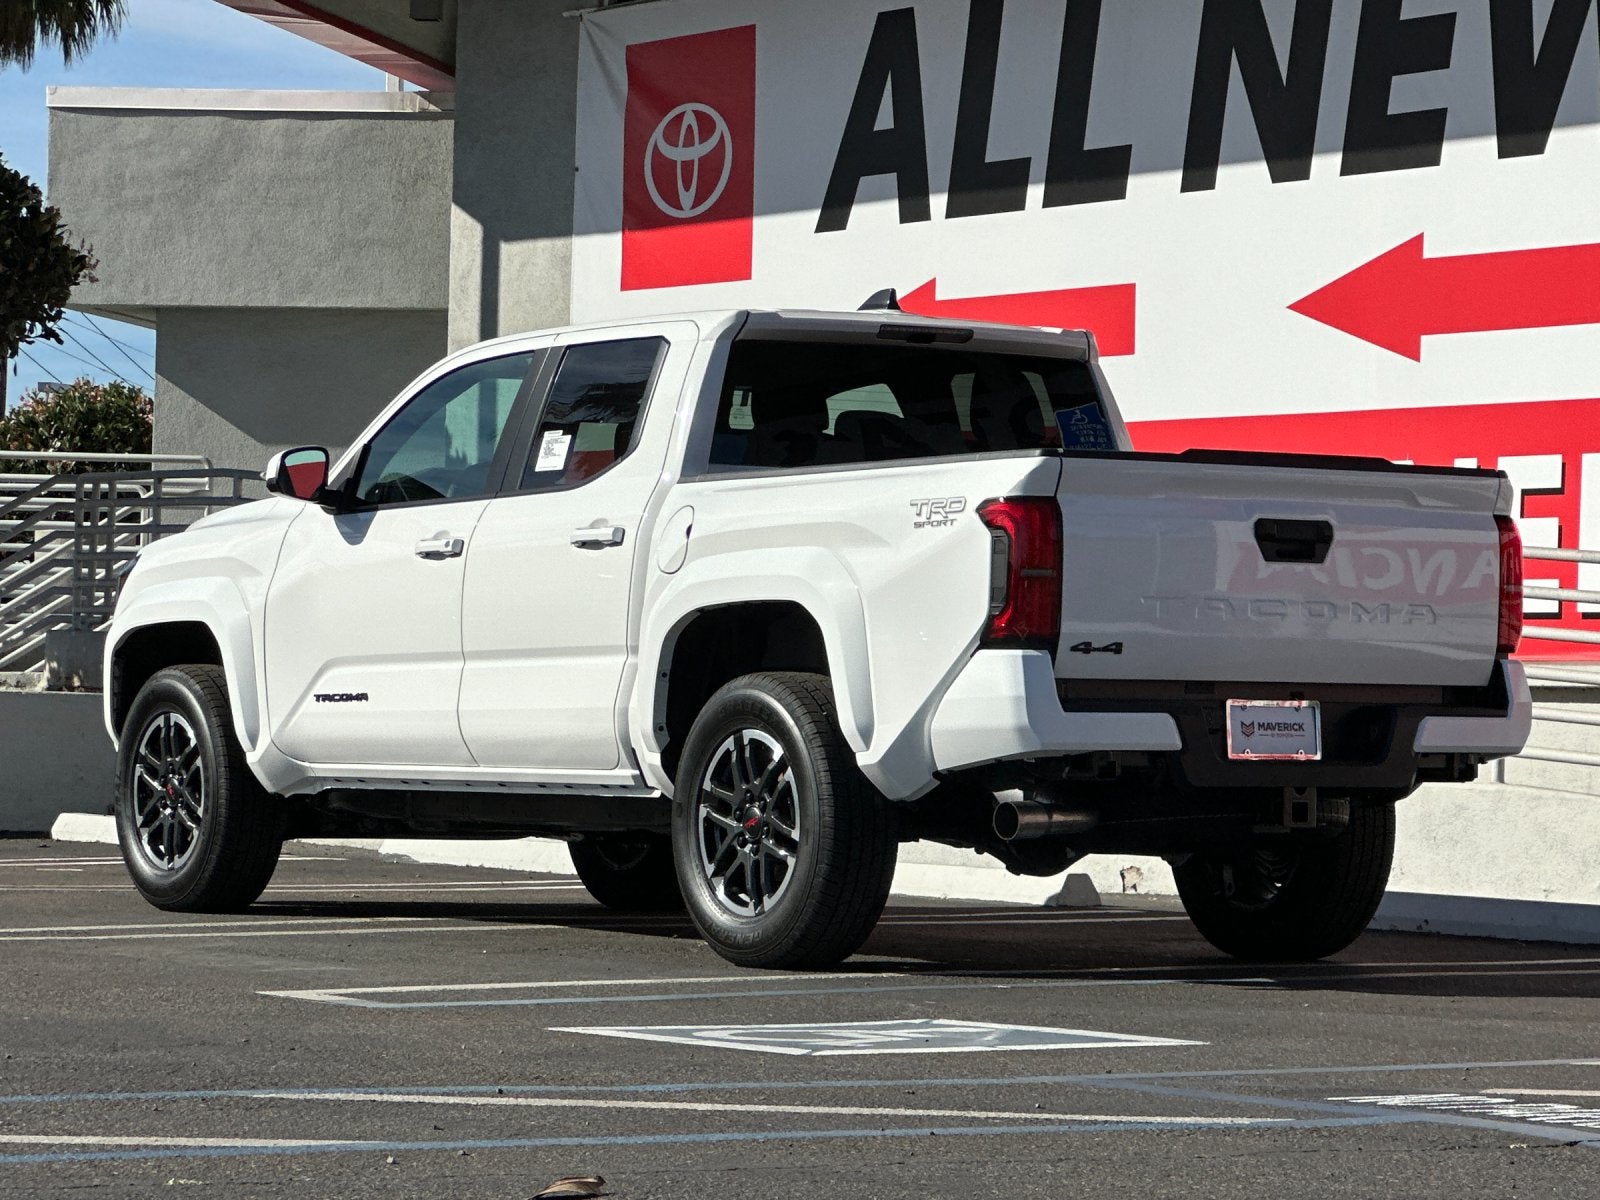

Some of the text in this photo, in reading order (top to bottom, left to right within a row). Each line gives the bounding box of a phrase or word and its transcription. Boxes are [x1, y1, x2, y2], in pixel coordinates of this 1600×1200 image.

[814, 0, 1133, 234] ALL
[909, 496, 967, 520] TRD
[913, 518, 957, 529] SPORT
[1141, 596, 1437, 625] TACOMA
[313, 692, 369, 703] TACOMA
[1257, 721, 1305, 732] MAVERICK
